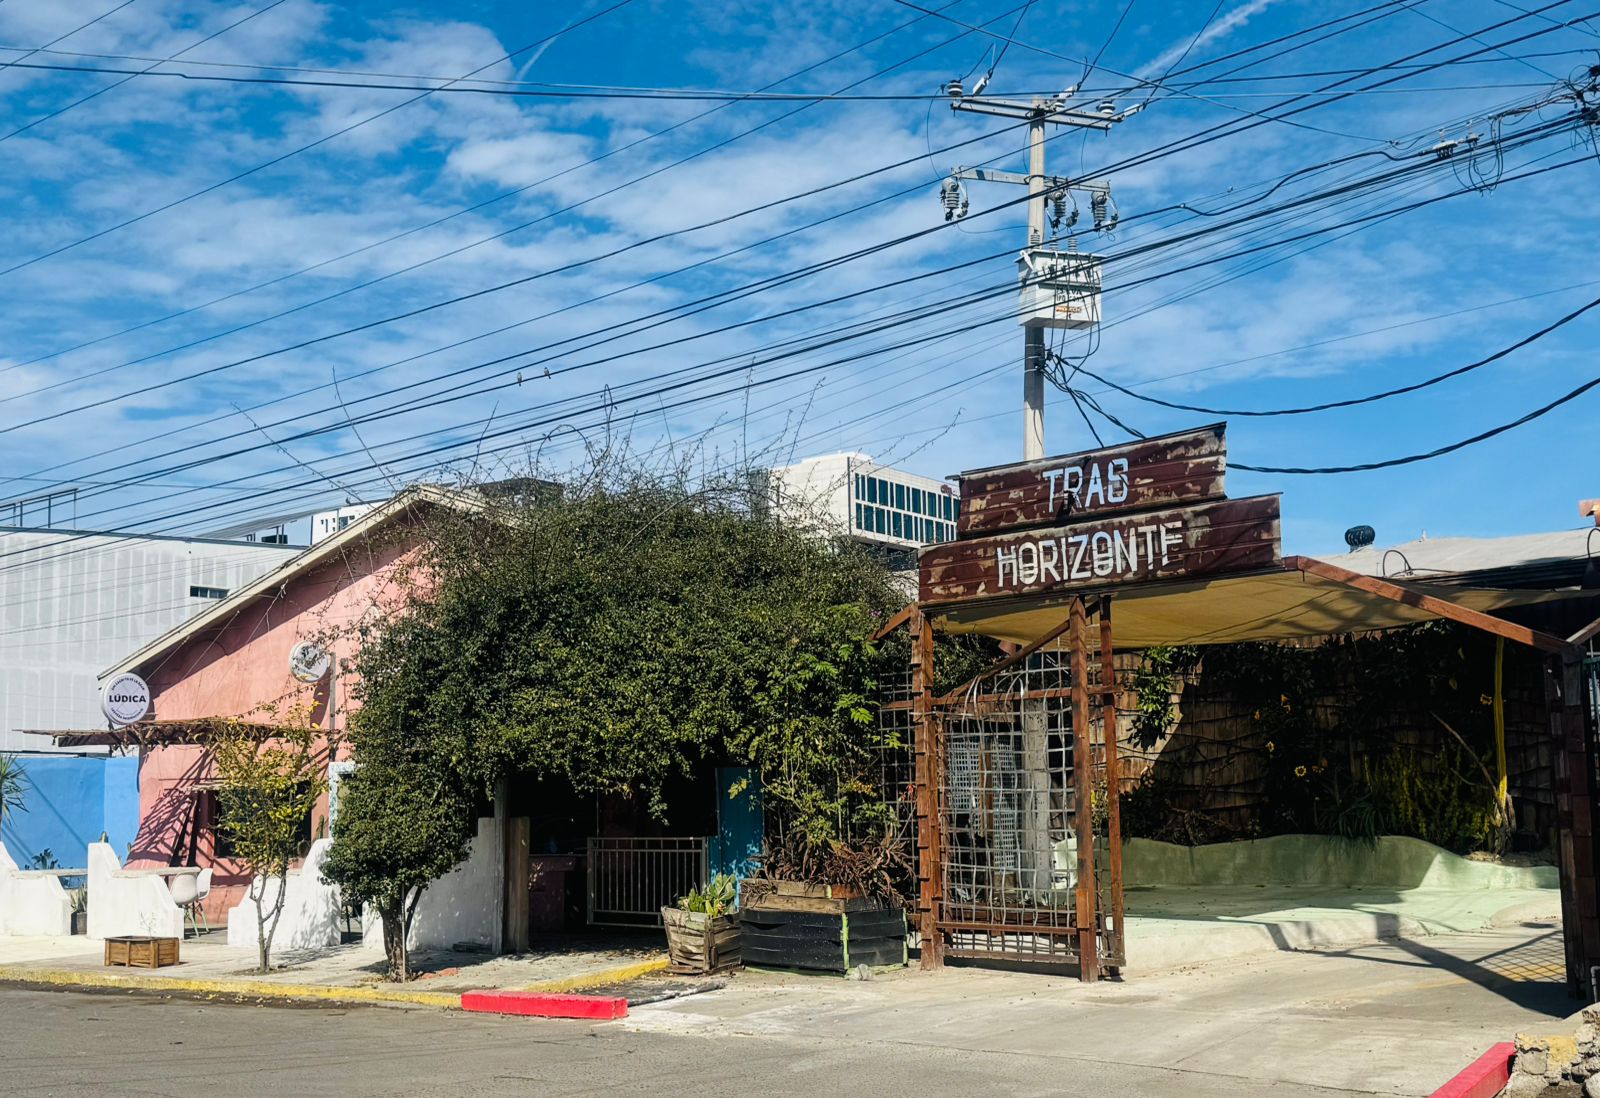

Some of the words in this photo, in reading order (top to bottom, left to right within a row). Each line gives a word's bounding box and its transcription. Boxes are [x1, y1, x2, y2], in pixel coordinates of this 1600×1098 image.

[1042, 457, 1129, 513] TRAS
[997, 520, 1184, 588] HORIZONTE
[109, 693, 147, 703] LÚDICA
